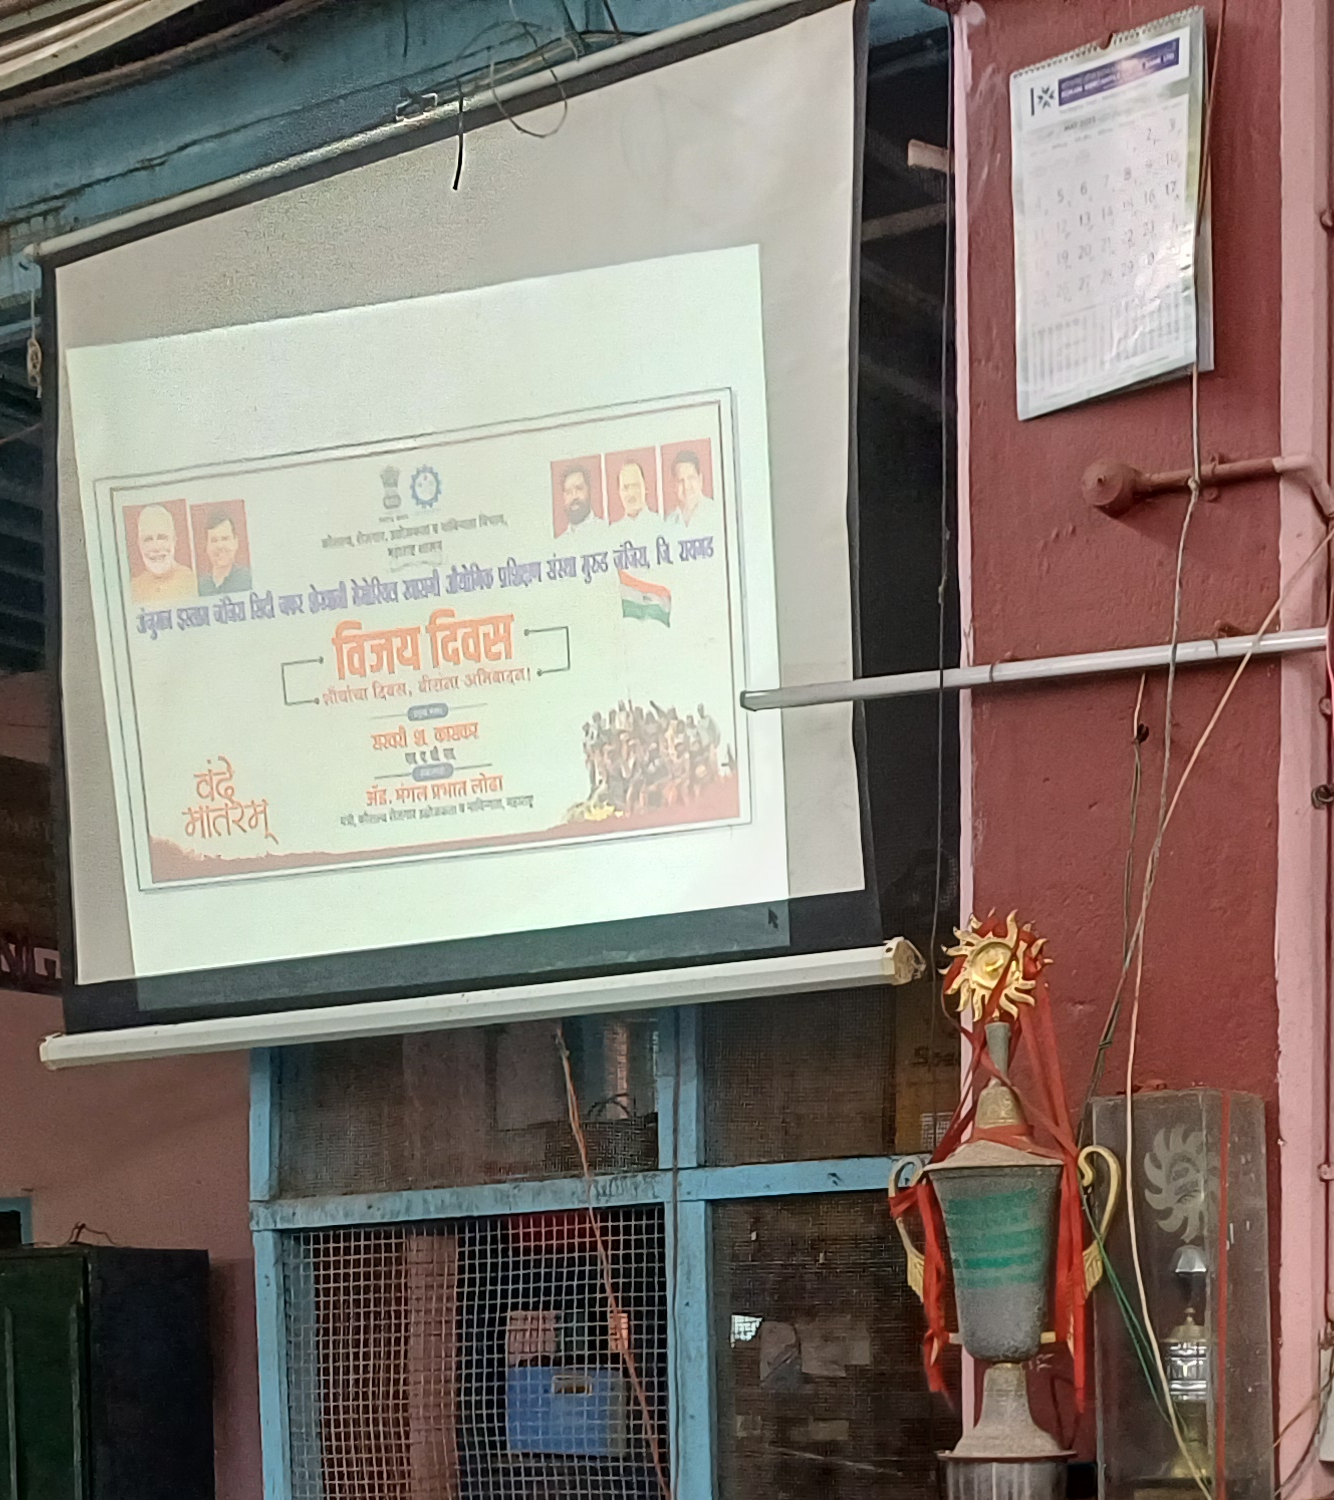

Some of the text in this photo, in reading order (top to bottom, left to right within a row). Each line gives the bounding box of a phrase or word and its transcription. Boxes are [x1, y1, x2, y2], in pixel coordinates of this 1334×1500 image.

[1057, 187, 1065, 204] 5
[1080, 180, 1088, 196] 6
[1165, 180, 1177, 196] 17
[332, 608, 515, 681] विजय दिवस
[193, 754, 236, 804] वंदे
[395, 781, 428, 804] मंगल
[430, 779, 468, 801] प्रभात
[471, 772, 504, 795] लोढा
[181, 798, 280, 846] मातरम्
